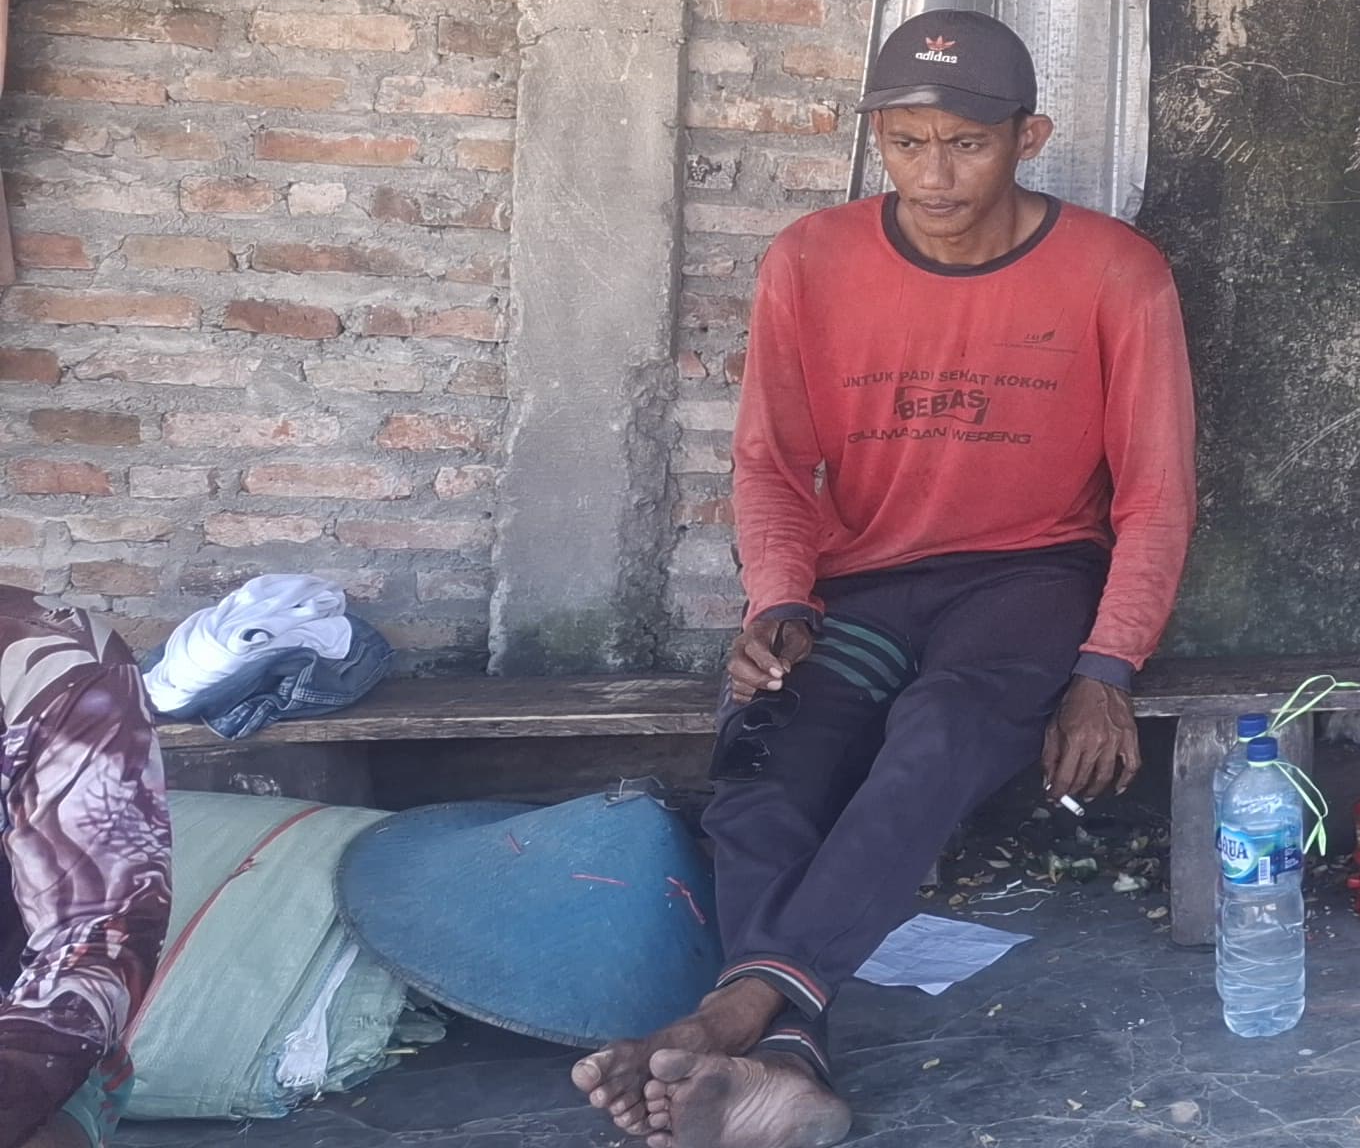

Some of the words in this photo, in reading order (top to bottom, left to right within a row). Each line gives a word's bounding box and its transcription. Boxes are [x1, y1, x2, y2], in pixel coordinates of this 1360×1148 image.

[914, 50, 958, 64] adidas
[842, 371, 894, 389] UNTUK
[899, 370, 934, 383] PADI
[938, 368, 990, 386] SEHAT
[994, 374, 1058, 392] KOKOH
[899, 389, 985, 420] BEBAS
[951, 426, 1033, 446] WERENG
